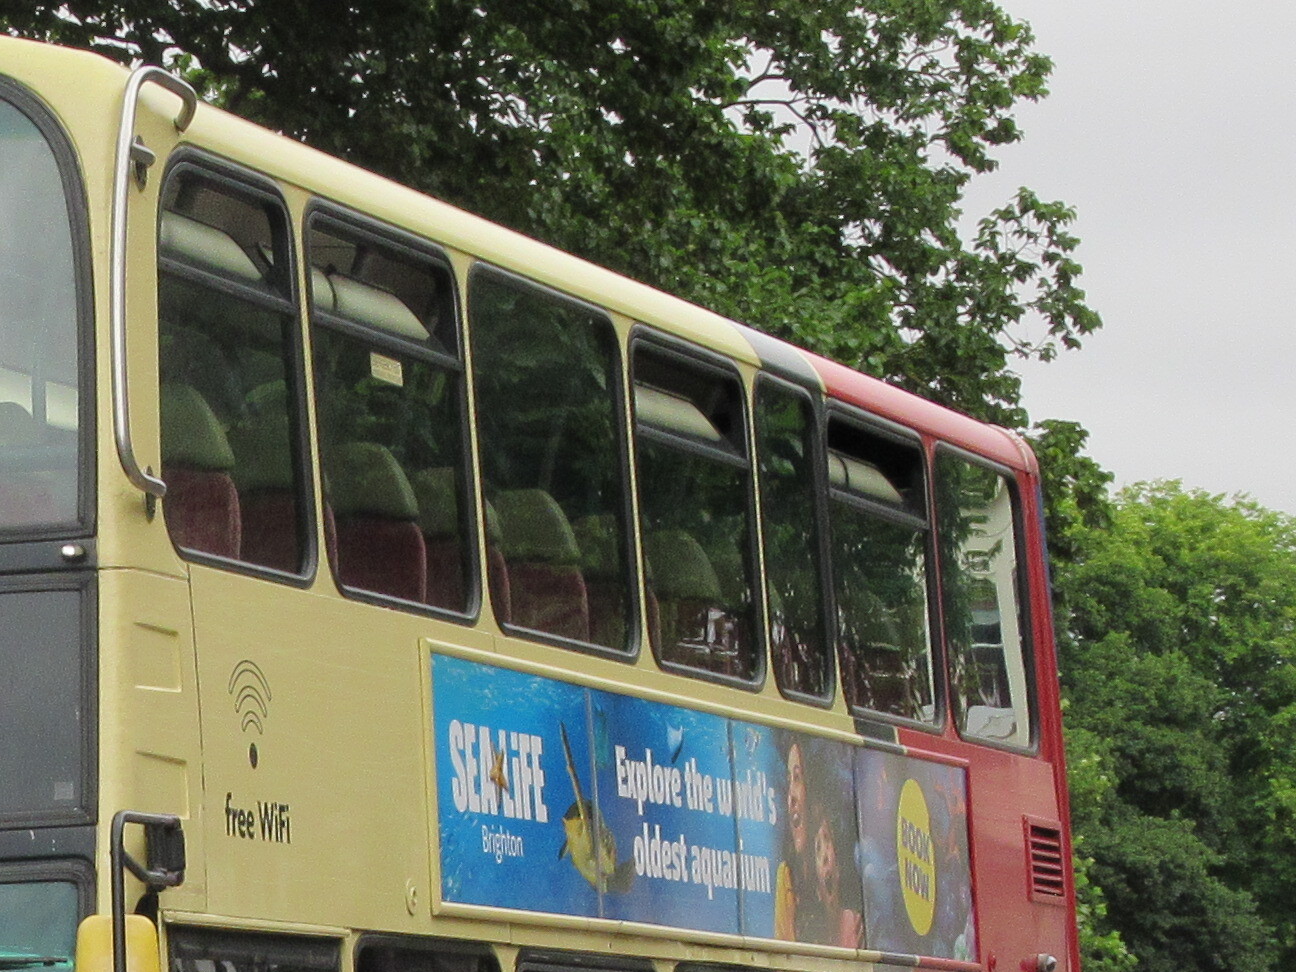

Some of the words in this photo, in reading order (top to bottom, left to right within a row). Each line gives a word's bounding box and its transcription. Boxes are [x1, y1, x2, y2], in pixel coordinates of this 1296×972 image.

[614, 744, 682, 816] Explore
[684, 757, 714, 814] the
[225, 791, 255, 840] free
[256, 800, 291, 844] WiFi
[901, 815, 931, 866] BOOK
[481, 824, 525, 865] Brighton
[633, 822, 689, 883] oldest
[904, 856, 931, 901] NOW
